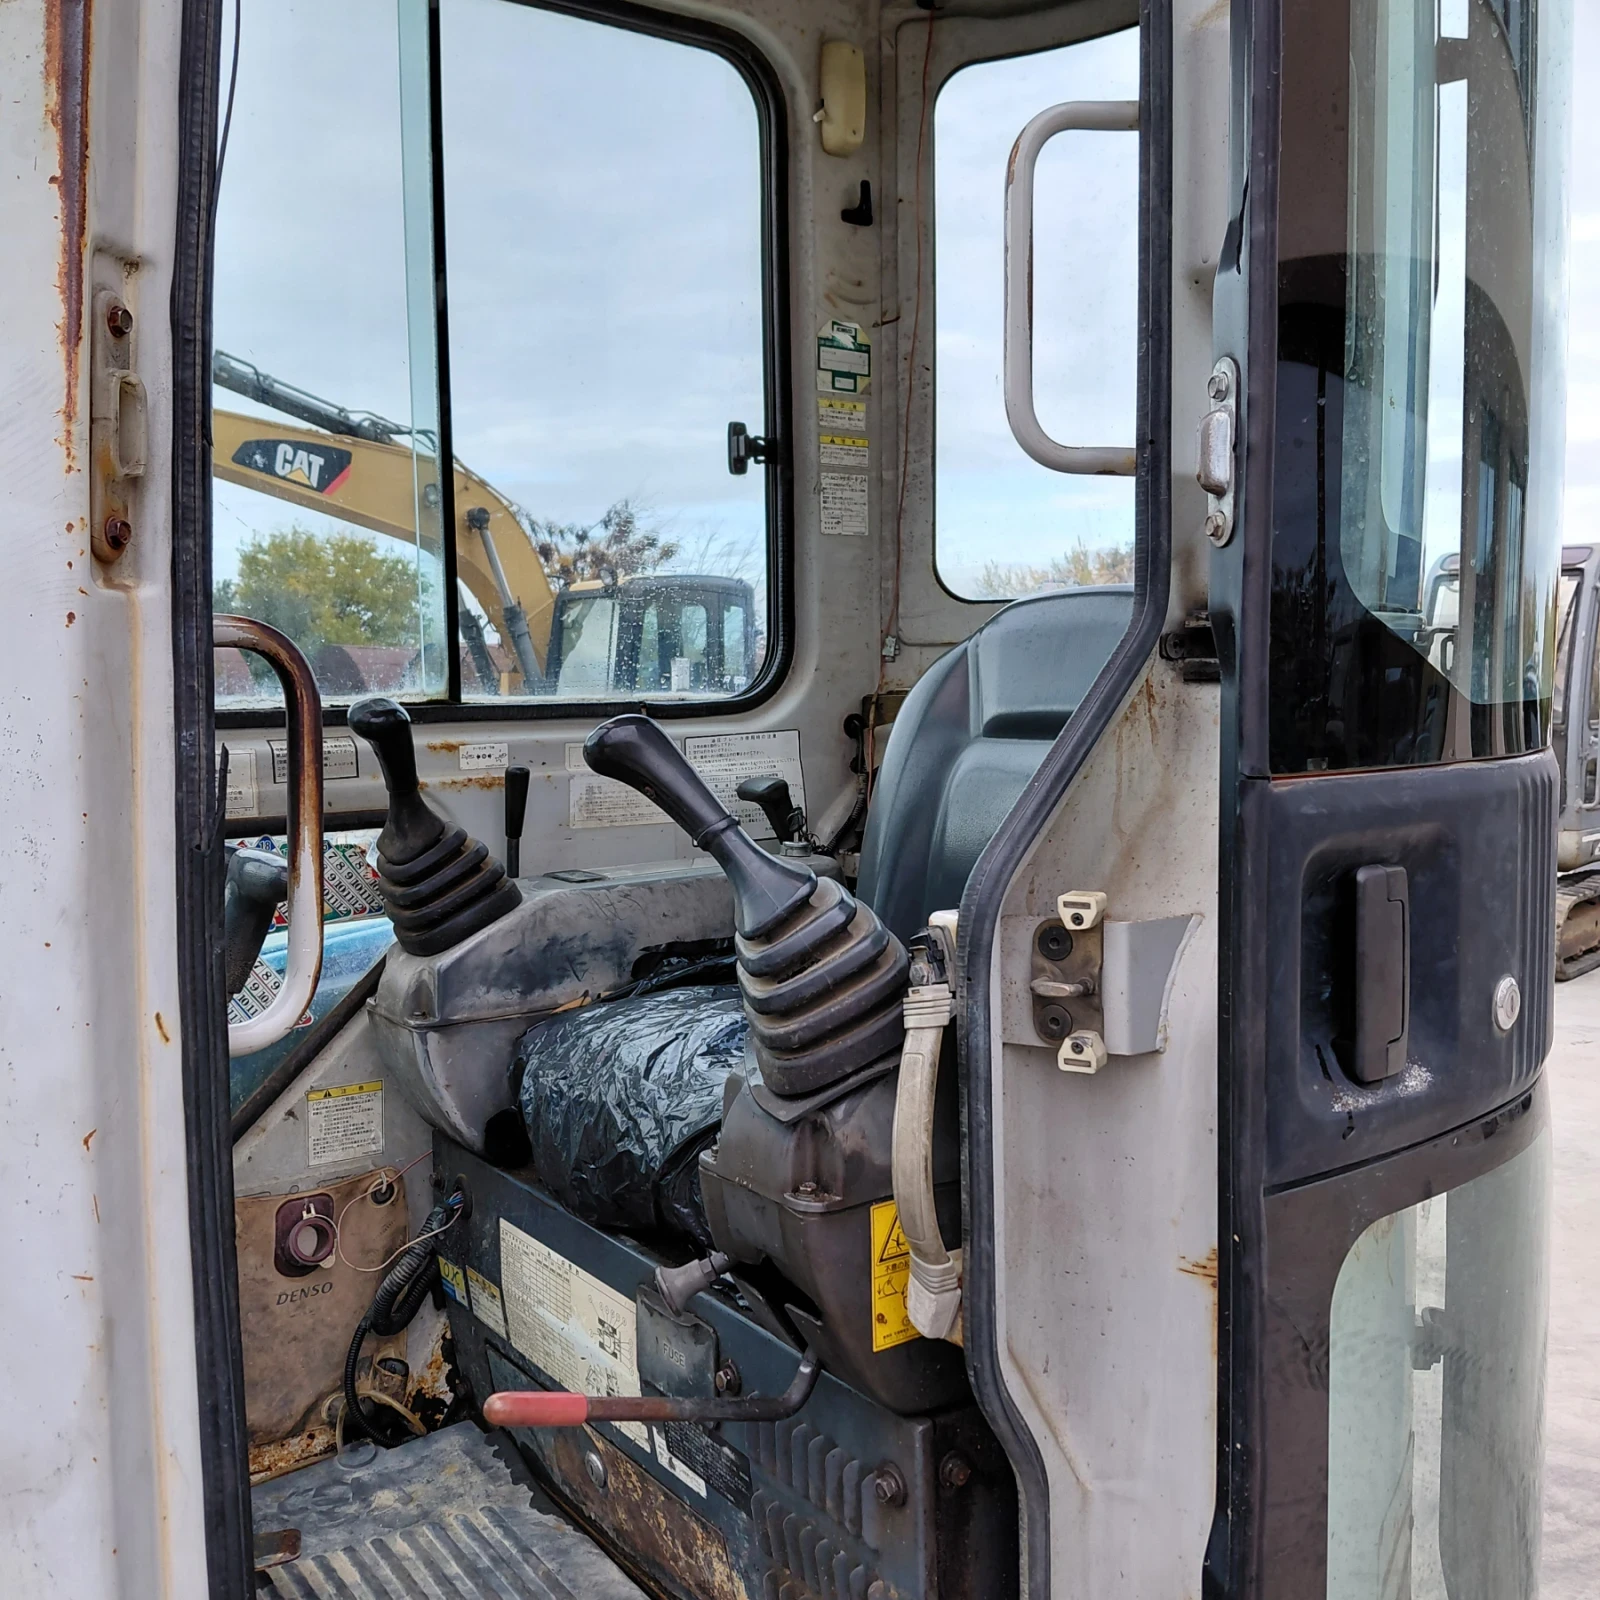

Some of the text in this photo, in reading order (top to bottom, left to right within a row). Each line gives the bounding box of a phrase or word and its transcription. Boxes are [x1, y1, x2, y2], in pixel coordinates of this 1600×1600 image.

[275, 443, 324, 488] CAT
[261, 841, 271, 851] 18
[327, 873, 364, 913] 9 10 11 12
[328, 851, 379, 912] 7 8 9 10 11 12
[327, 893, 339, 906] 11
[336, 903, 348, 916] 12
[254, 960, 280, 990] 7 8 9
[250, 982, 270, 1003] 9 10
[238, 994, 258, 1016] 10 11
[276, 1281, 333, 1305] DENSO
[663, 1343, 685, 1367] FUSE
